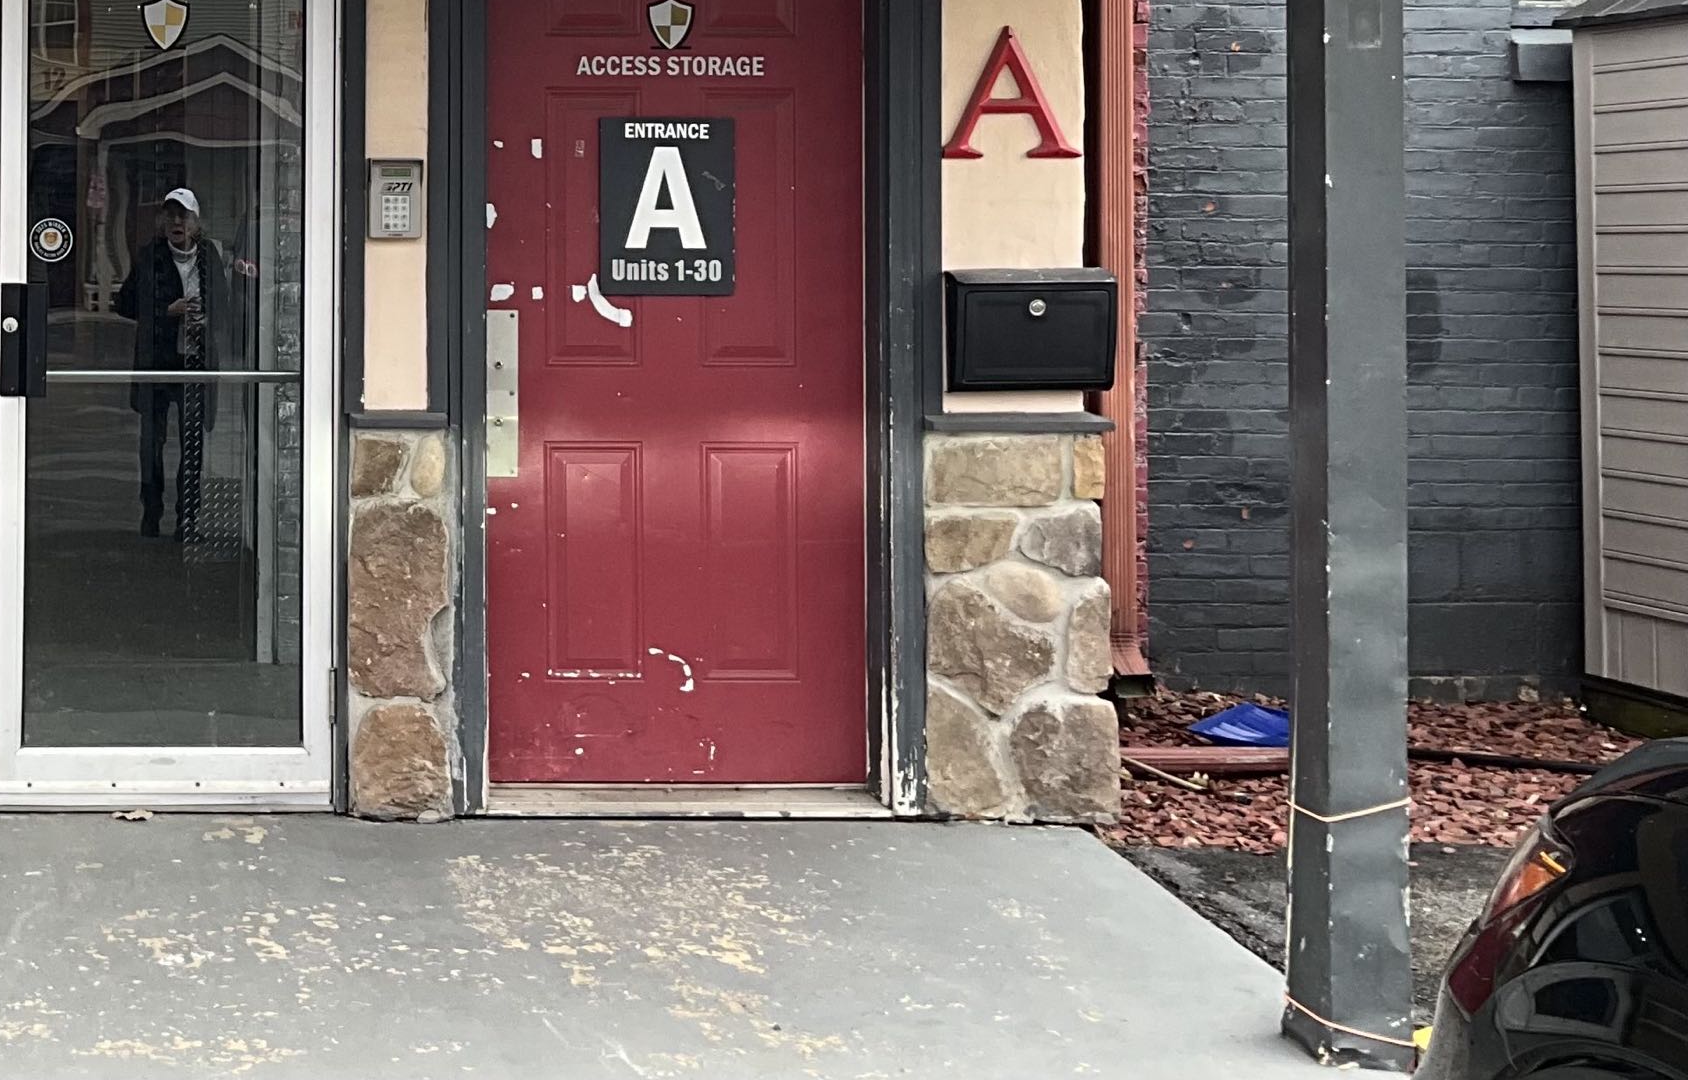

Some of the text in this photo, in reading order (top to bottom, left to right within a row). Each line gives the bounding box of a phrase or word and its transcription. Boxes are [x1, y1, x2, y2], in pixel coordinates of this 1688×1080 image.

[576, 56, 765, 77] ACCESS STORAGE
[942, 25, 1082, 159] A
[624, 122, 710, 139] ENTRANCE
[624, 146, 707, 249] A
[611, 258, 722, 282] Units 1-30
